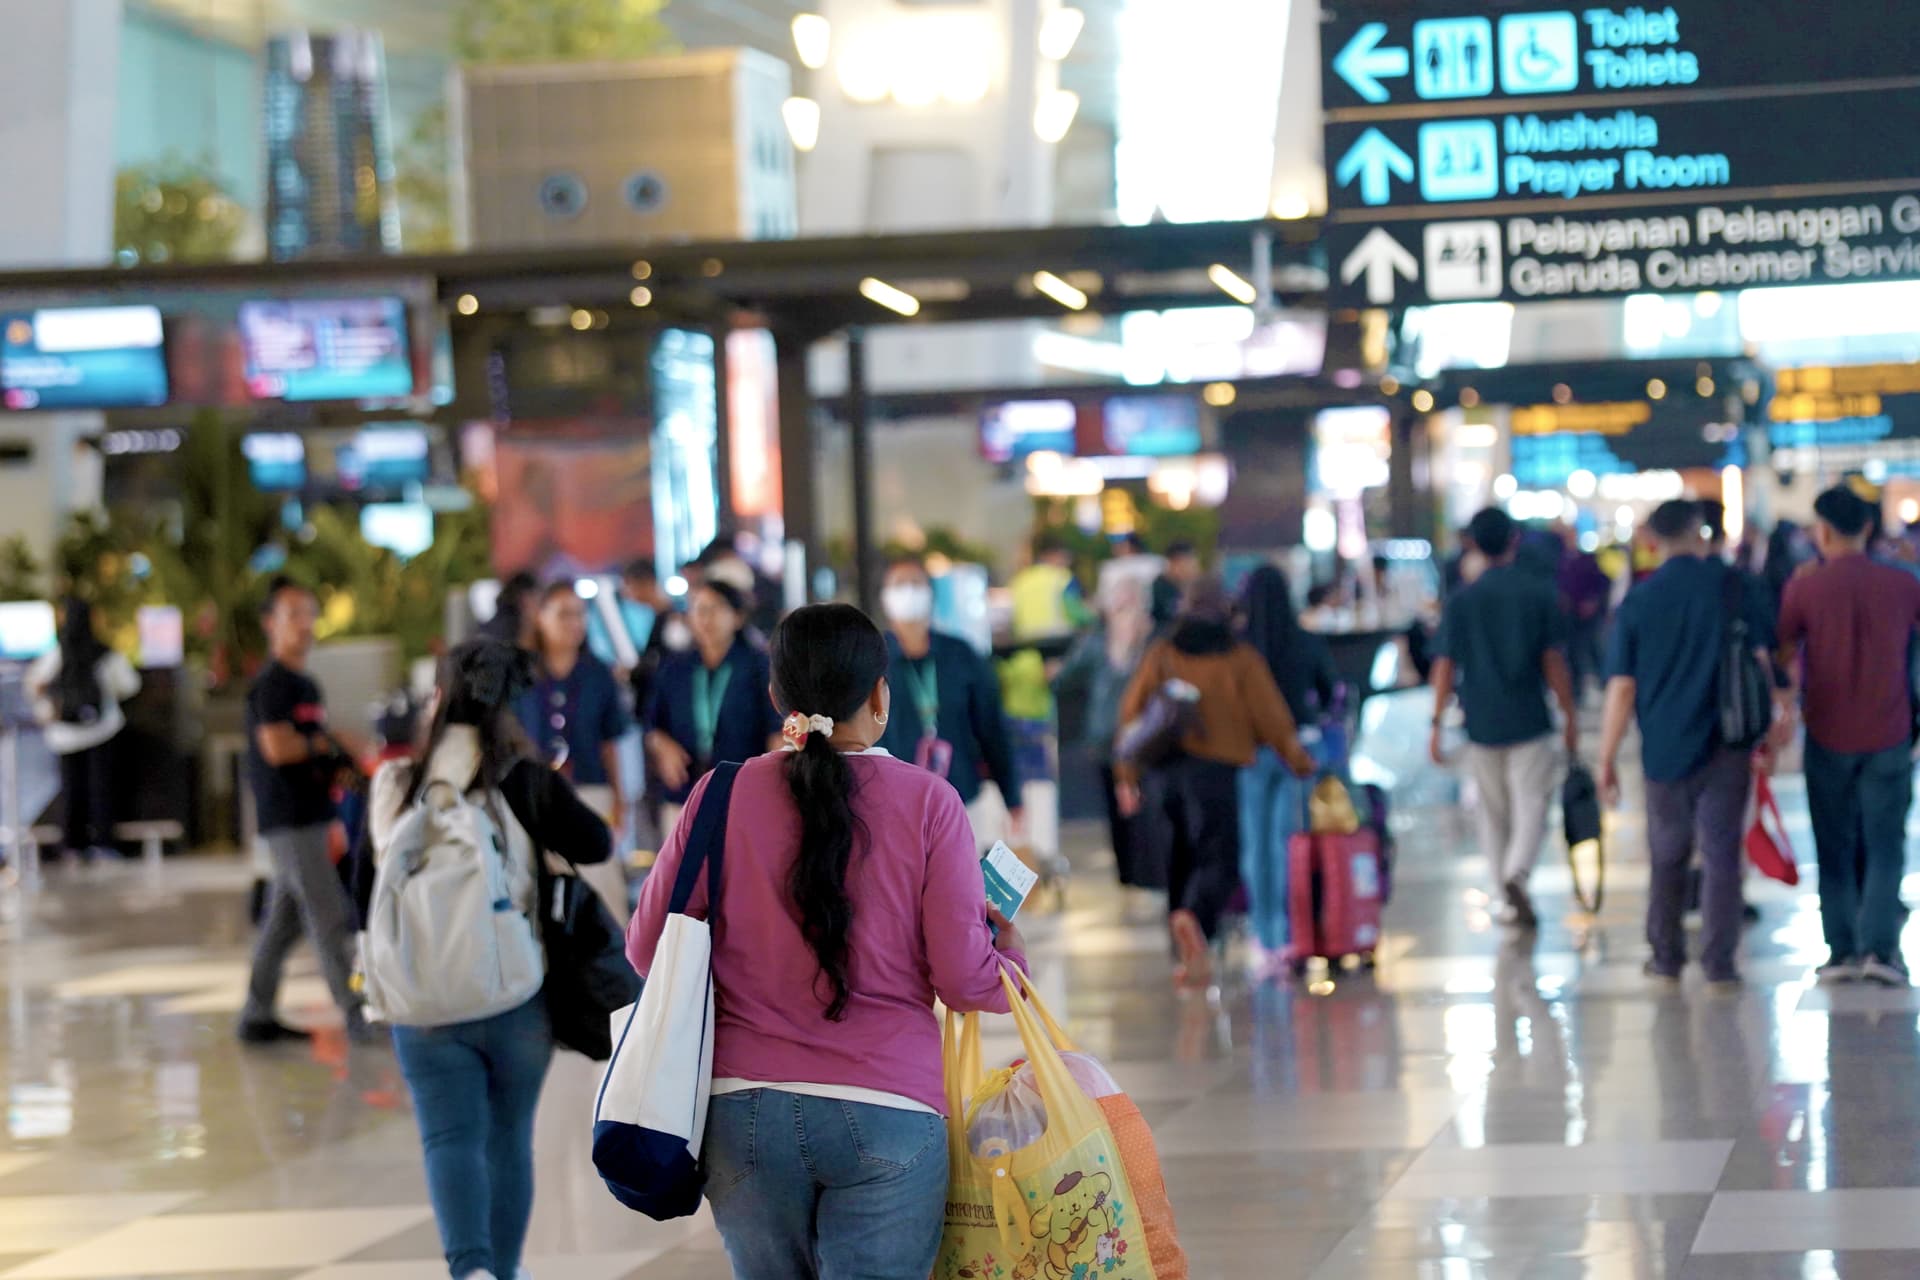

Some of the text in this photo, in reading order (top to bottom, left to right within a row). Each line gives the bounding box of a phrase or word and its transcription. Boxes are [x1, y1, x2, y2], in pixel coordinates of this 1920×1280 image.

[1583, 6, 1680, 48] Toilet
[1584, 48, 1699, 88] Toilets
[1504, 110, 1658, 153] Musholla
[1504, 149, 1730, 199] Prayer Room
[1507, 195, 1920, 260] Pelayanan Pelanggan G
[1509, 253, 1641, 296] Garuda
[1645, 248, 1817, 288] Customer
